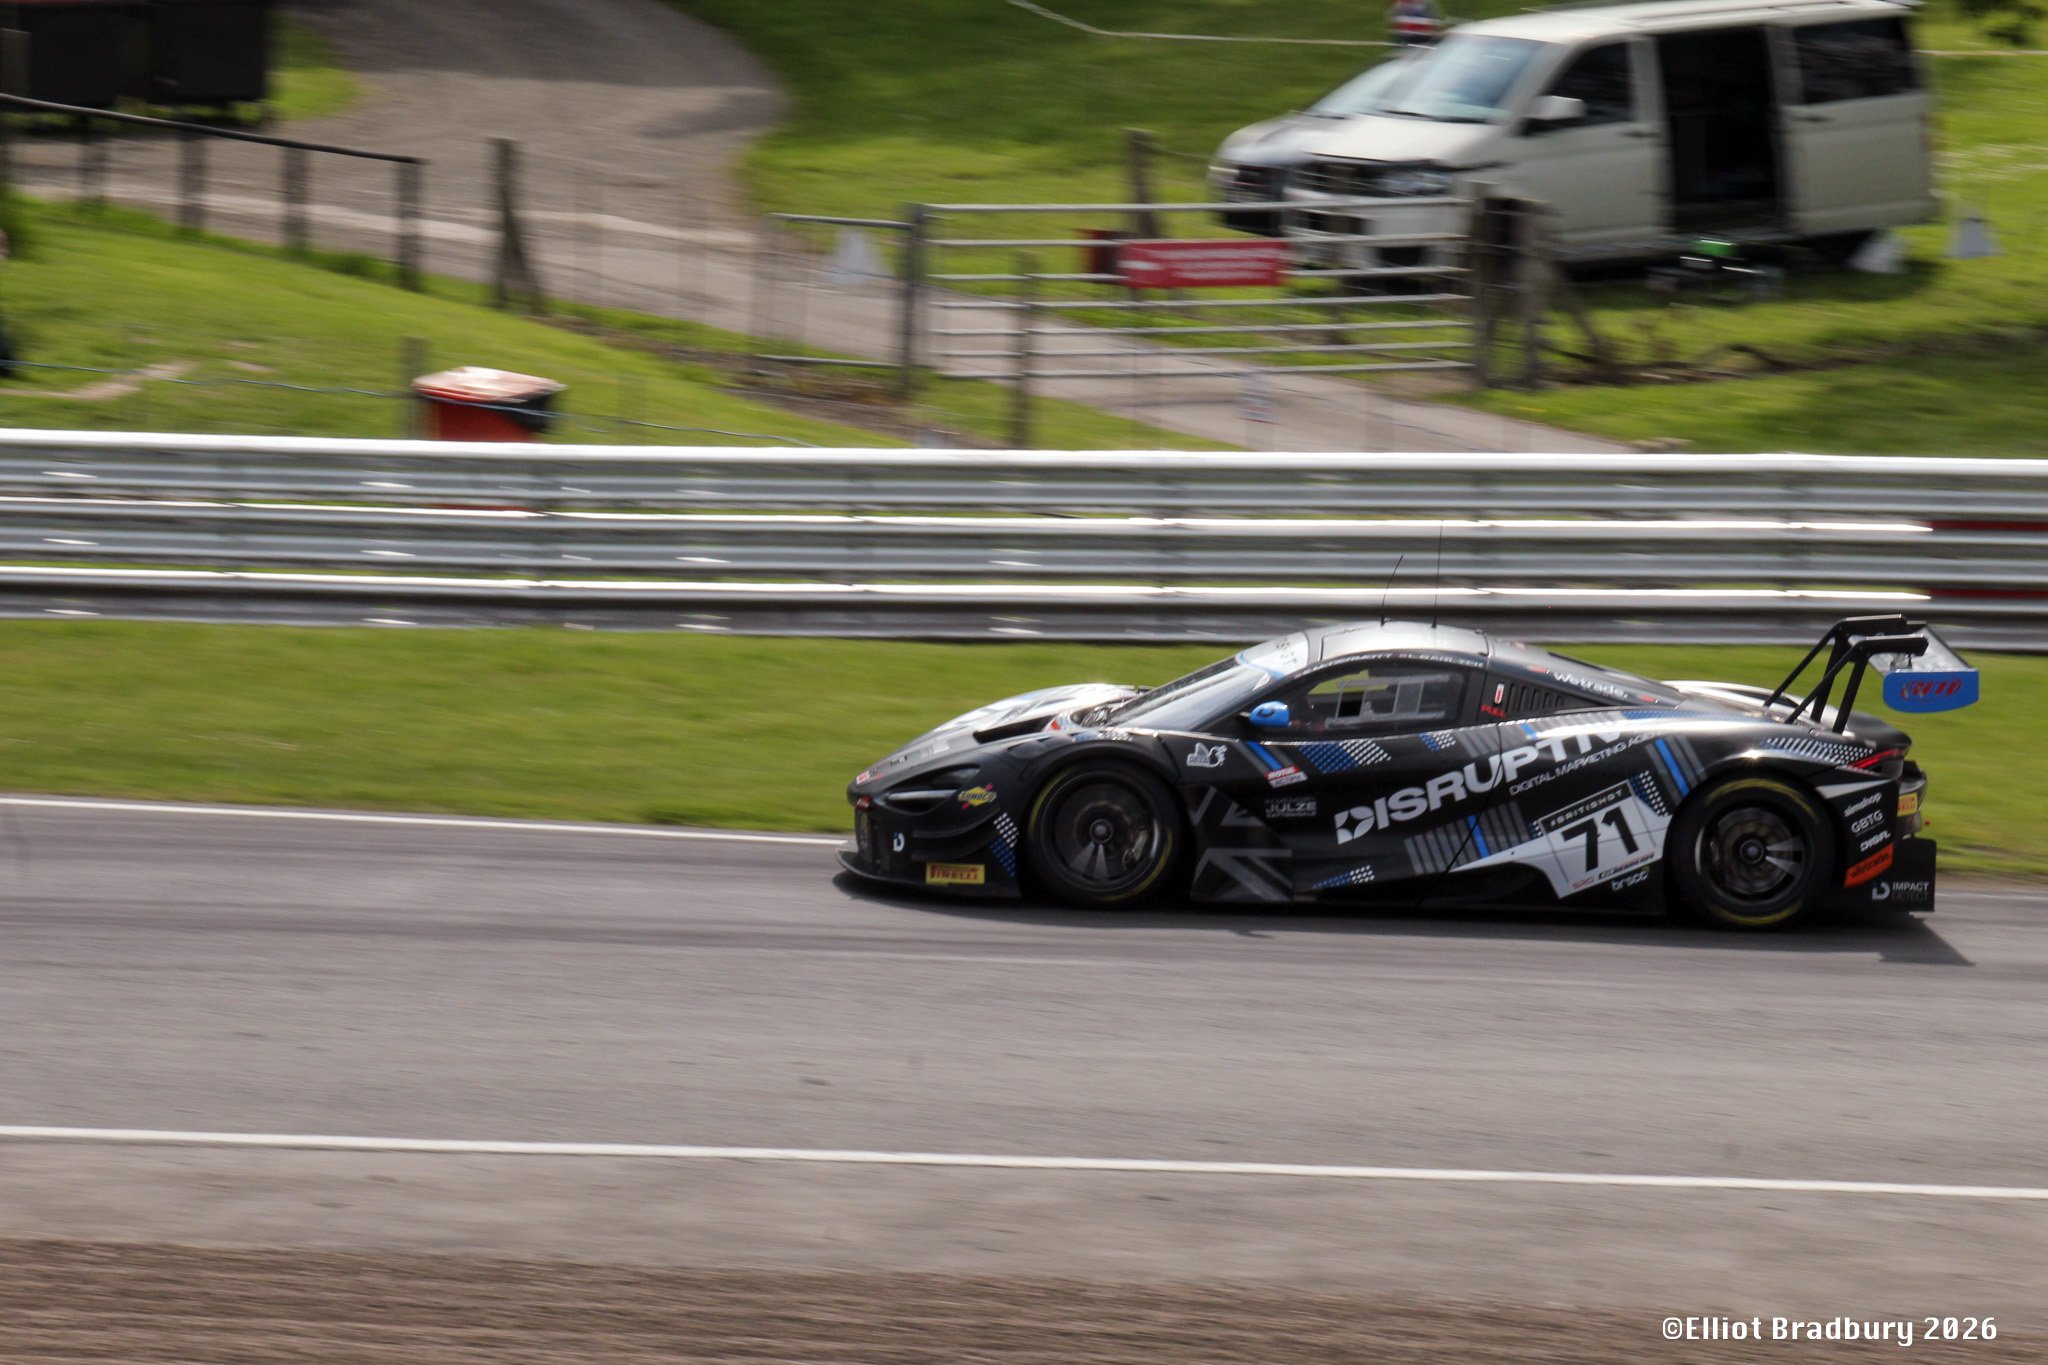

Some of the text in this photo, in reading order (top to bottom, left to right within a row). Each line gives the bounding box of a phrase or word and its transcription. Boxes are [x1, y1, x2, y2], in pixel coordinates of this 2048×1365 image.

[1481, 704, 1506, 717] PULL
[1509, 771, 1556, 796] DIGITAL
[1554, 743, 1627, 778] MARKETING
[958, 791, 997, 801] SUNOCO
[1851, 809, 1883, 833] GBTG
[1561, 806, 1639, 873] 71
[930, 864, 979, 881] PIRELLI
[1892, 881, 1930, 891] IMPACT
